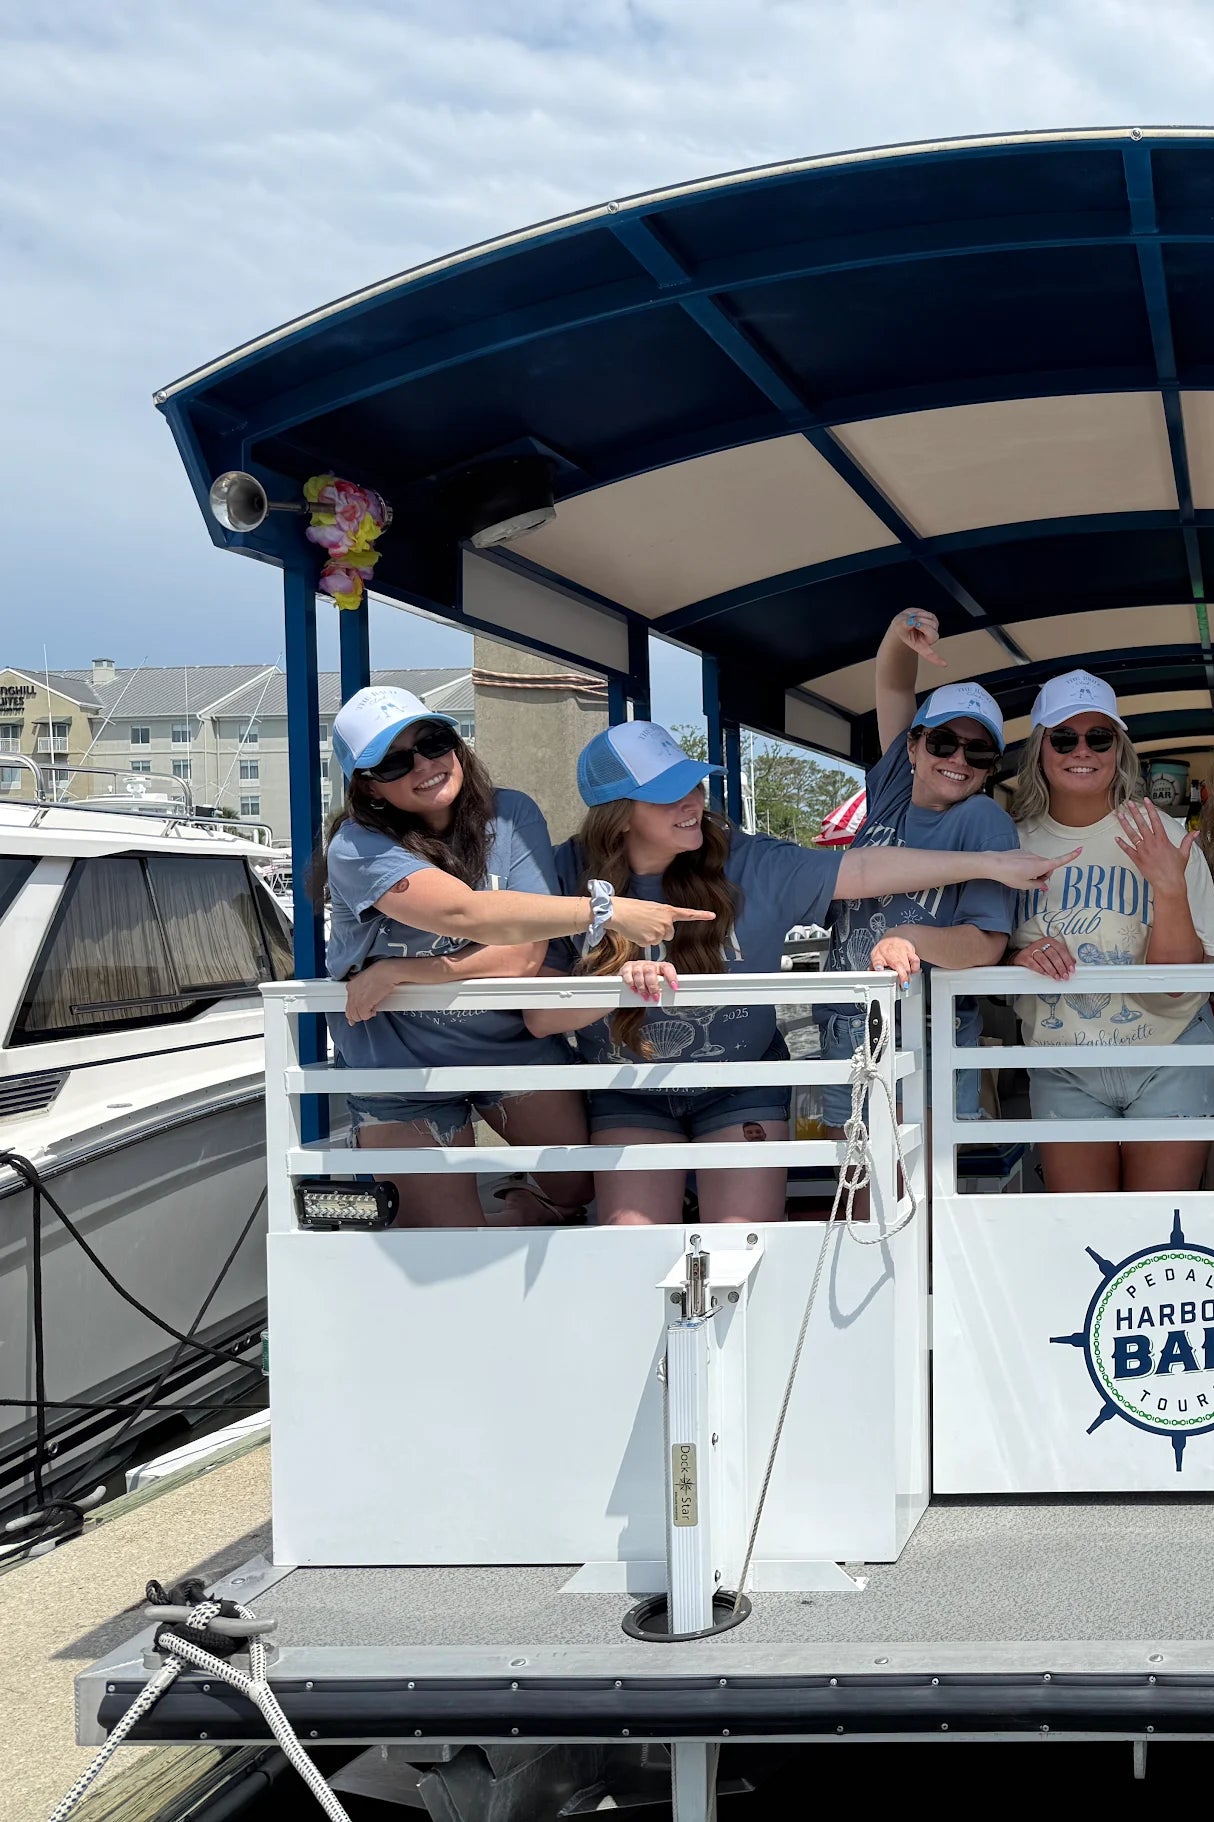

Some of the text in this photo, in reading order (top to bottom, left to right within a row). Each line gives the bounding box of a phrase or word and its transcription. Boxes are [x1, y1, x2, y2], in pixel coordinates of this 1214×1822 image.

[1042, 907, 1102, 939] Club
[722, 1008, 749, 1022] 2025
[1126, 1268, 1214, 1299] PEDAL
[680, 1445, 691, 1521] Dock Star
